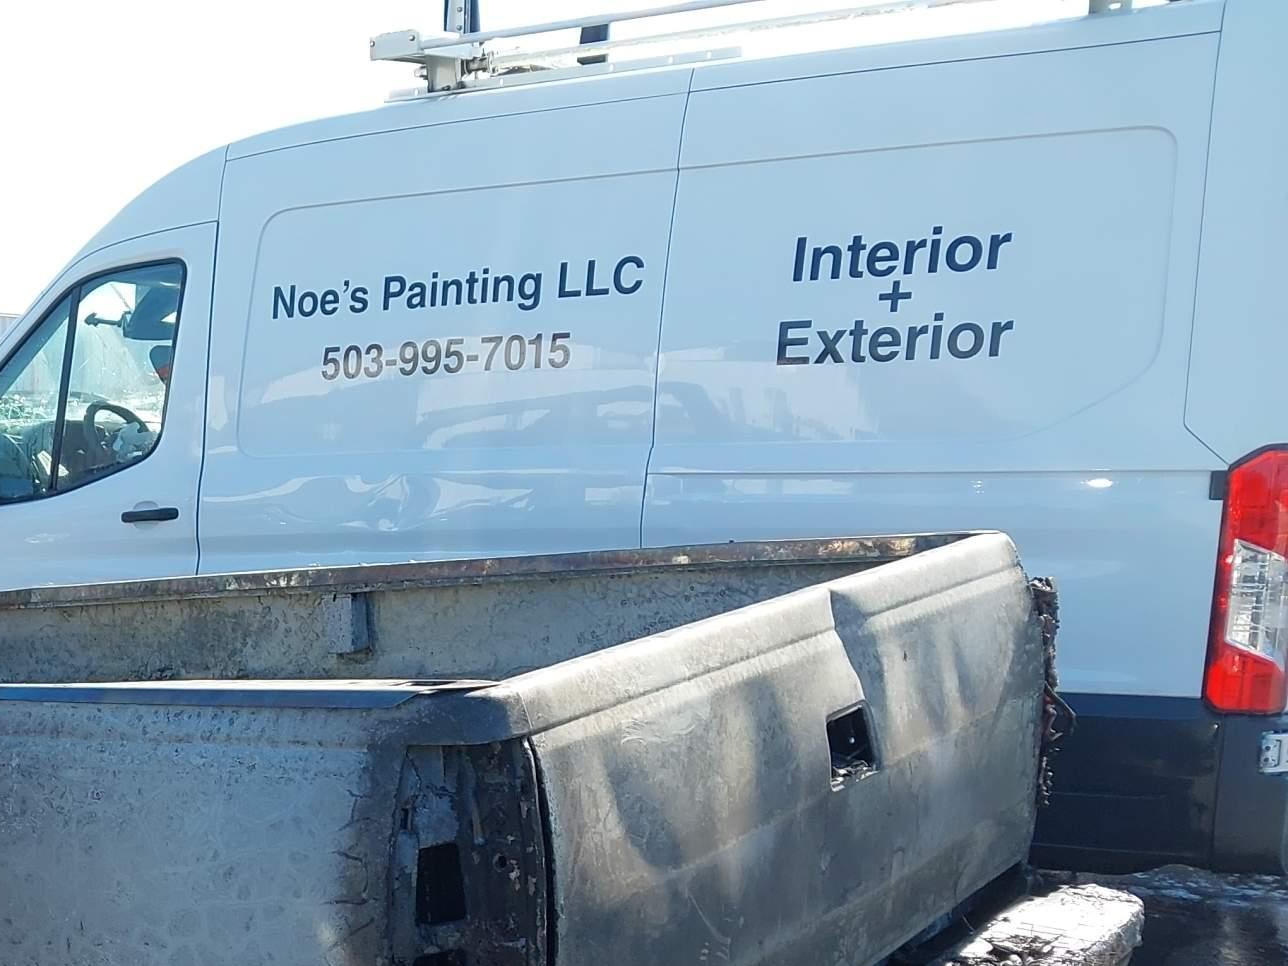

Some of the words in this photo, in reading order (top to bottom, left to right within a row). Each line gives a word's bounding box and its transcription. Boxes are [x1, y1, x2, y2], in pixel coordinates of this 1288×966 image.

[792, 225, 1013, 283] Interior
[273, 278, 368, 320] Noe's
[382, 265, 545, 312] Painting
[557, 255, 645, 299] LLC
[878, 279, 913, 313] +
[321, 331, 571, 381] 503-995-7015
[776, 310, 1015, 366] Exterior
